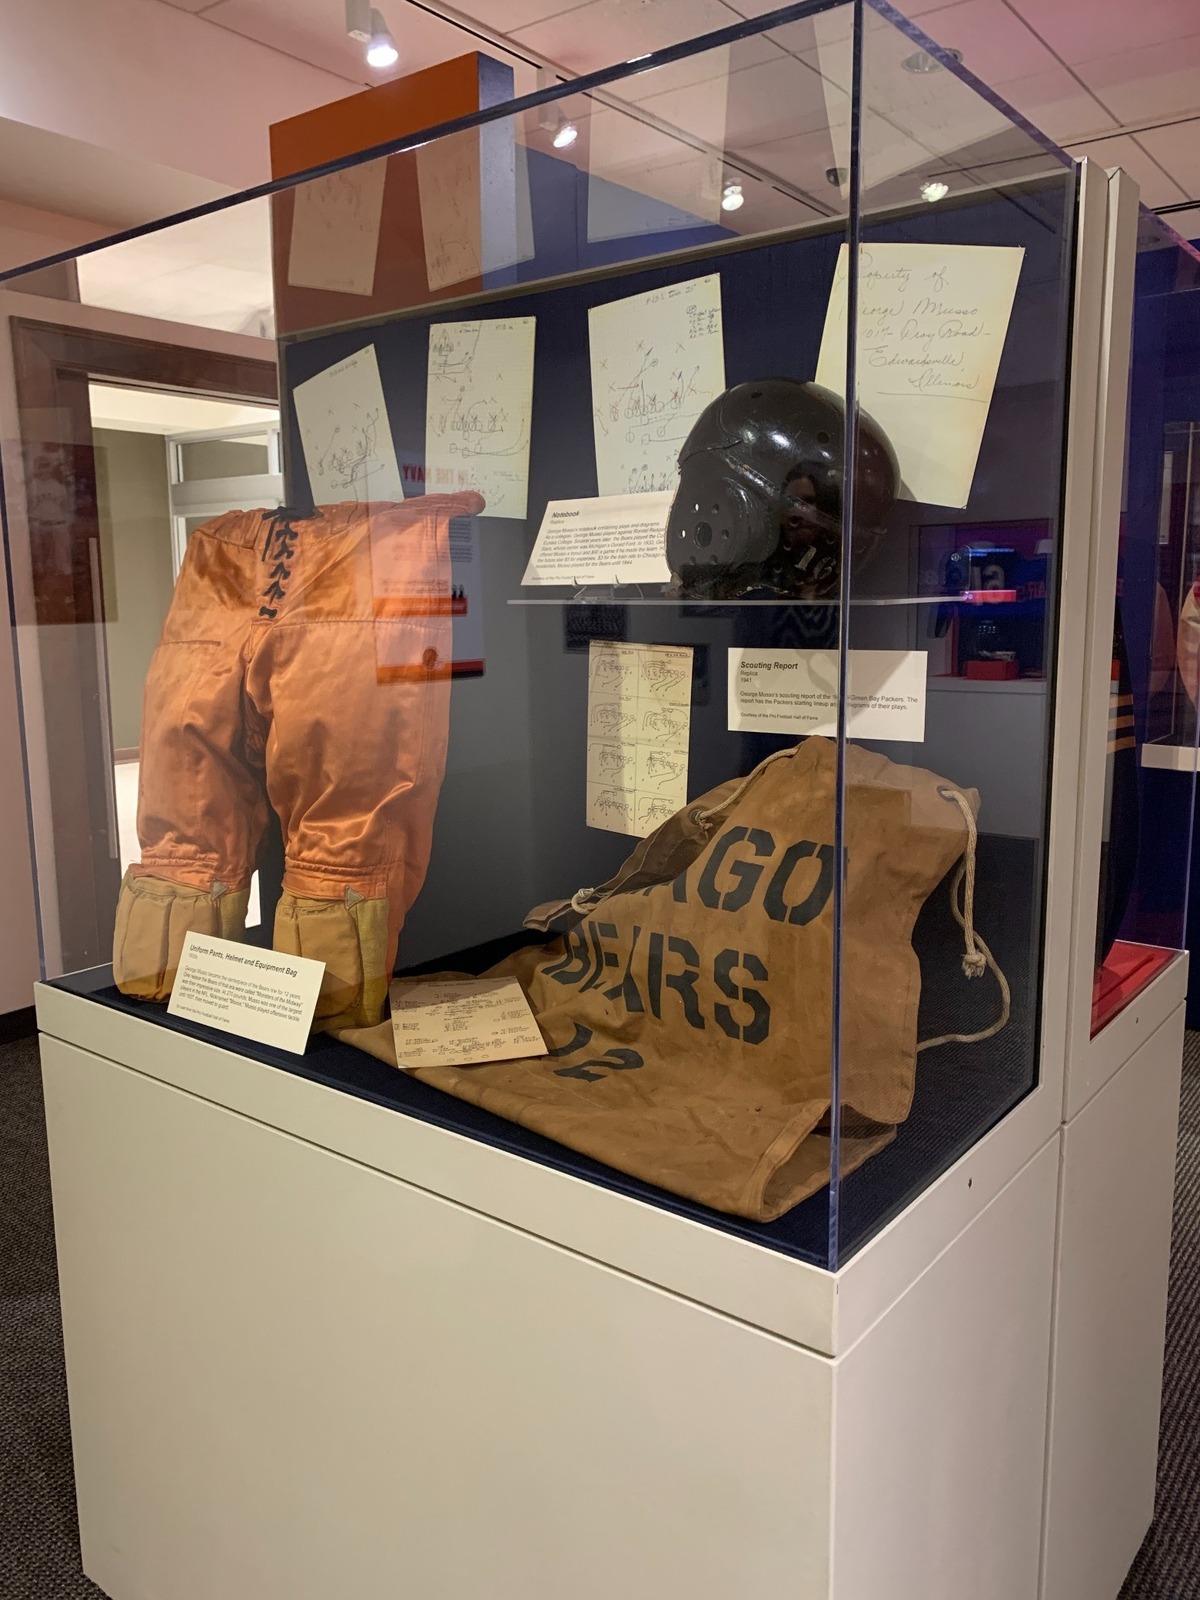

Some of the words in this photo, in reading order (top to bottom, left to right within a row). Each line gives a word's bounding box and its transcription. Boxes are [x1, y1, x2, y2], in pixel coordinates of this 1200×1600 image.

[913, 297, 978, 316] Musso
[552, 510, 581, 518] Notebook
[740, 662, 772, 670] Scouting
[774, 662, 798, 671] Report
[189, 944, 209, 955] Uniform
[208, 949, 224, 959] Pants,
[224, 953, 244, 963] Helmet
[254, 960, 286, 974] Equipment
[285, 967, 298, 978] Bag
[541, 921, 771, 1045] BEARS
